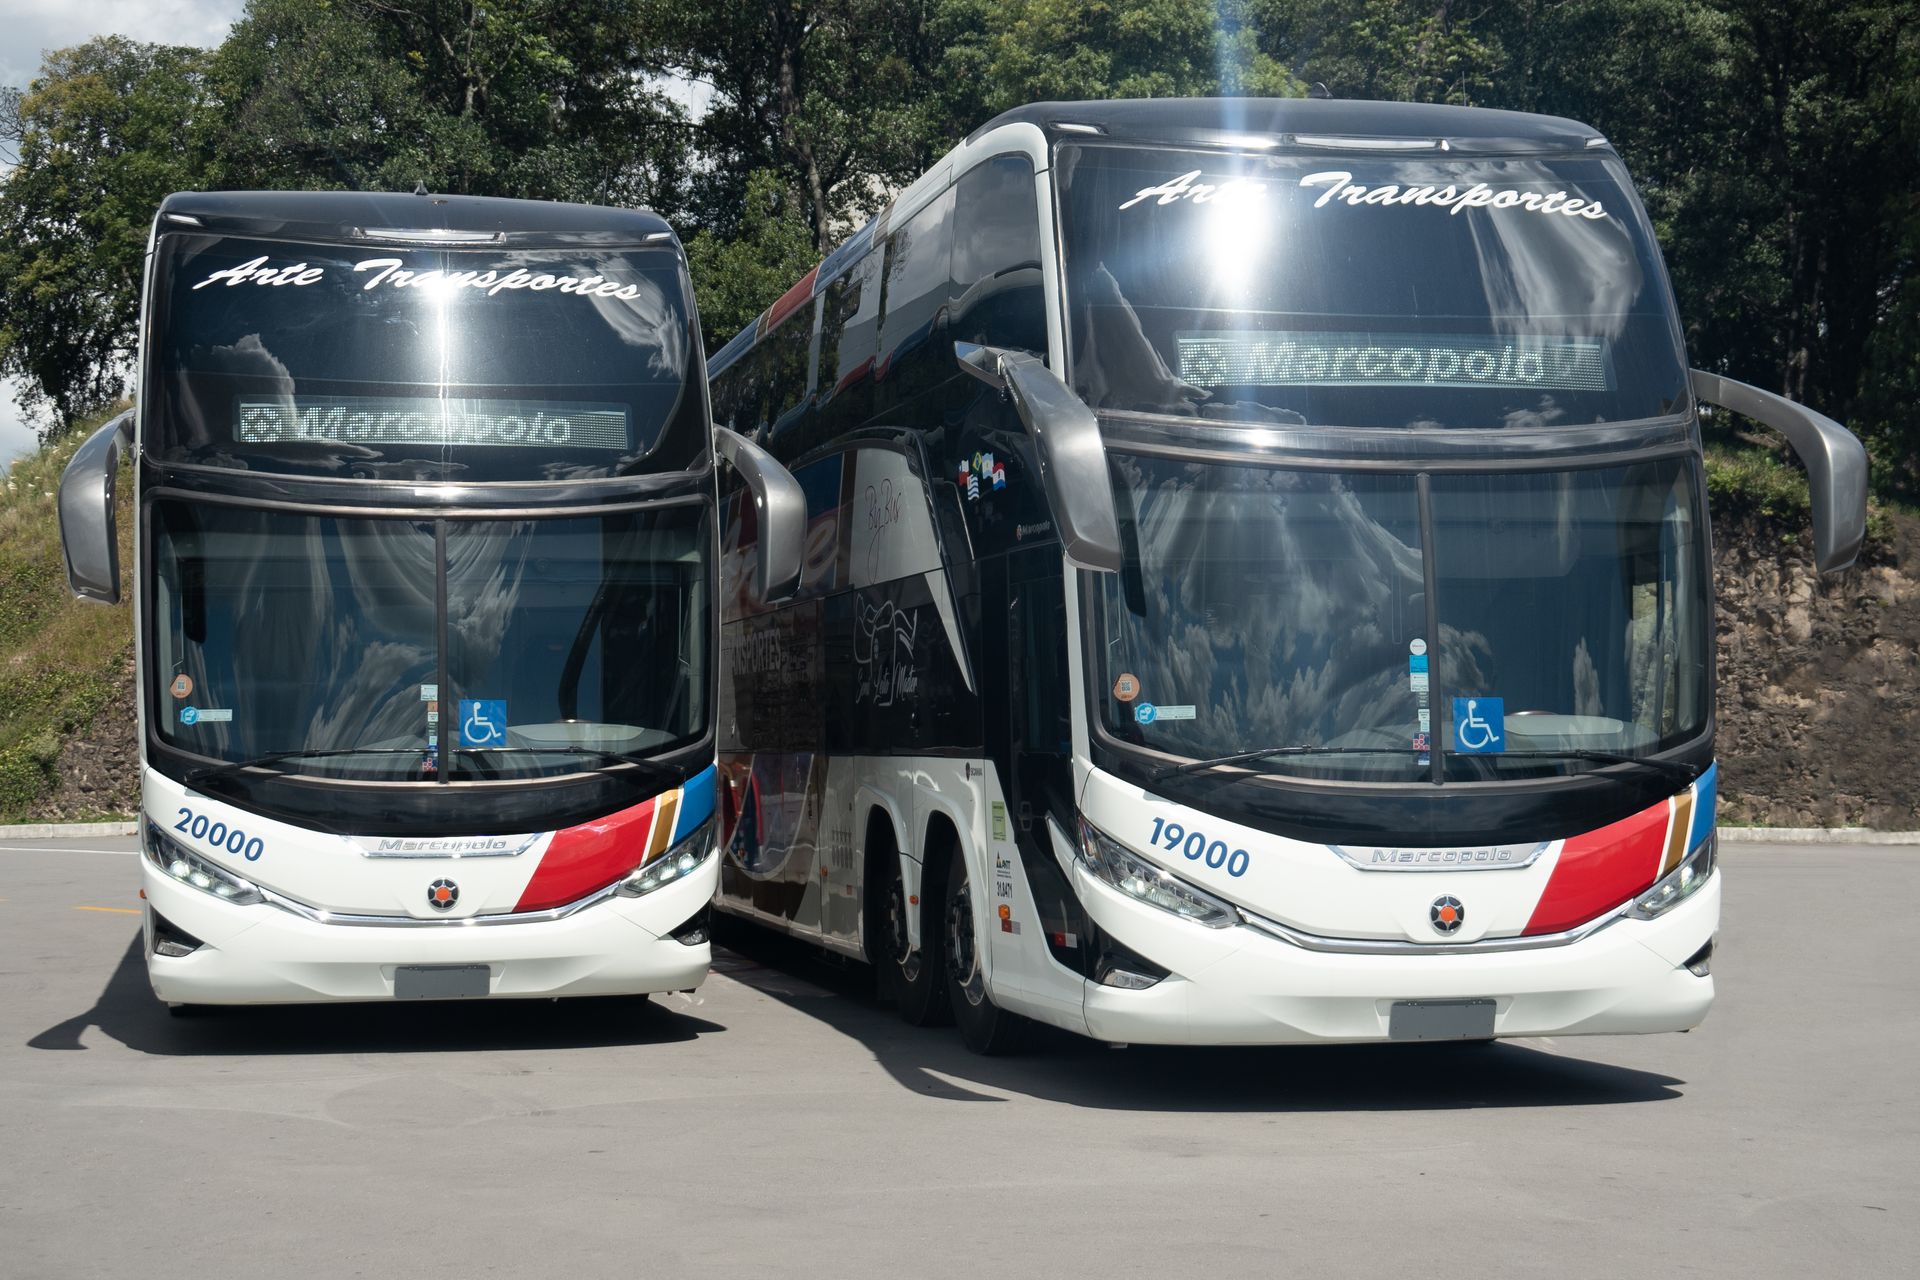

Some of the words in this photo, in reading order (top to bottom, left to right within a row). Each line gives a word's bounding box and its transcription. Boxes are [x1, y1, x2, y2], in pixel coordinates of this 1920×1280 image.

[1119, 170, 1268, 209] Art
[1299, 171, 1608, 219] Transportes
[192, 255, 324, 290] Arte
[353, 257, 642, 300] Transportes
[1246, 340, 1545, 384] Marcopolo
[174, 807, 264, 861] 20000
[378, 838, 507, 852] Marcopolo
[1150, 816, 1250, 877] 19000
[1371, 846, 1513, 864] Marcopolo
